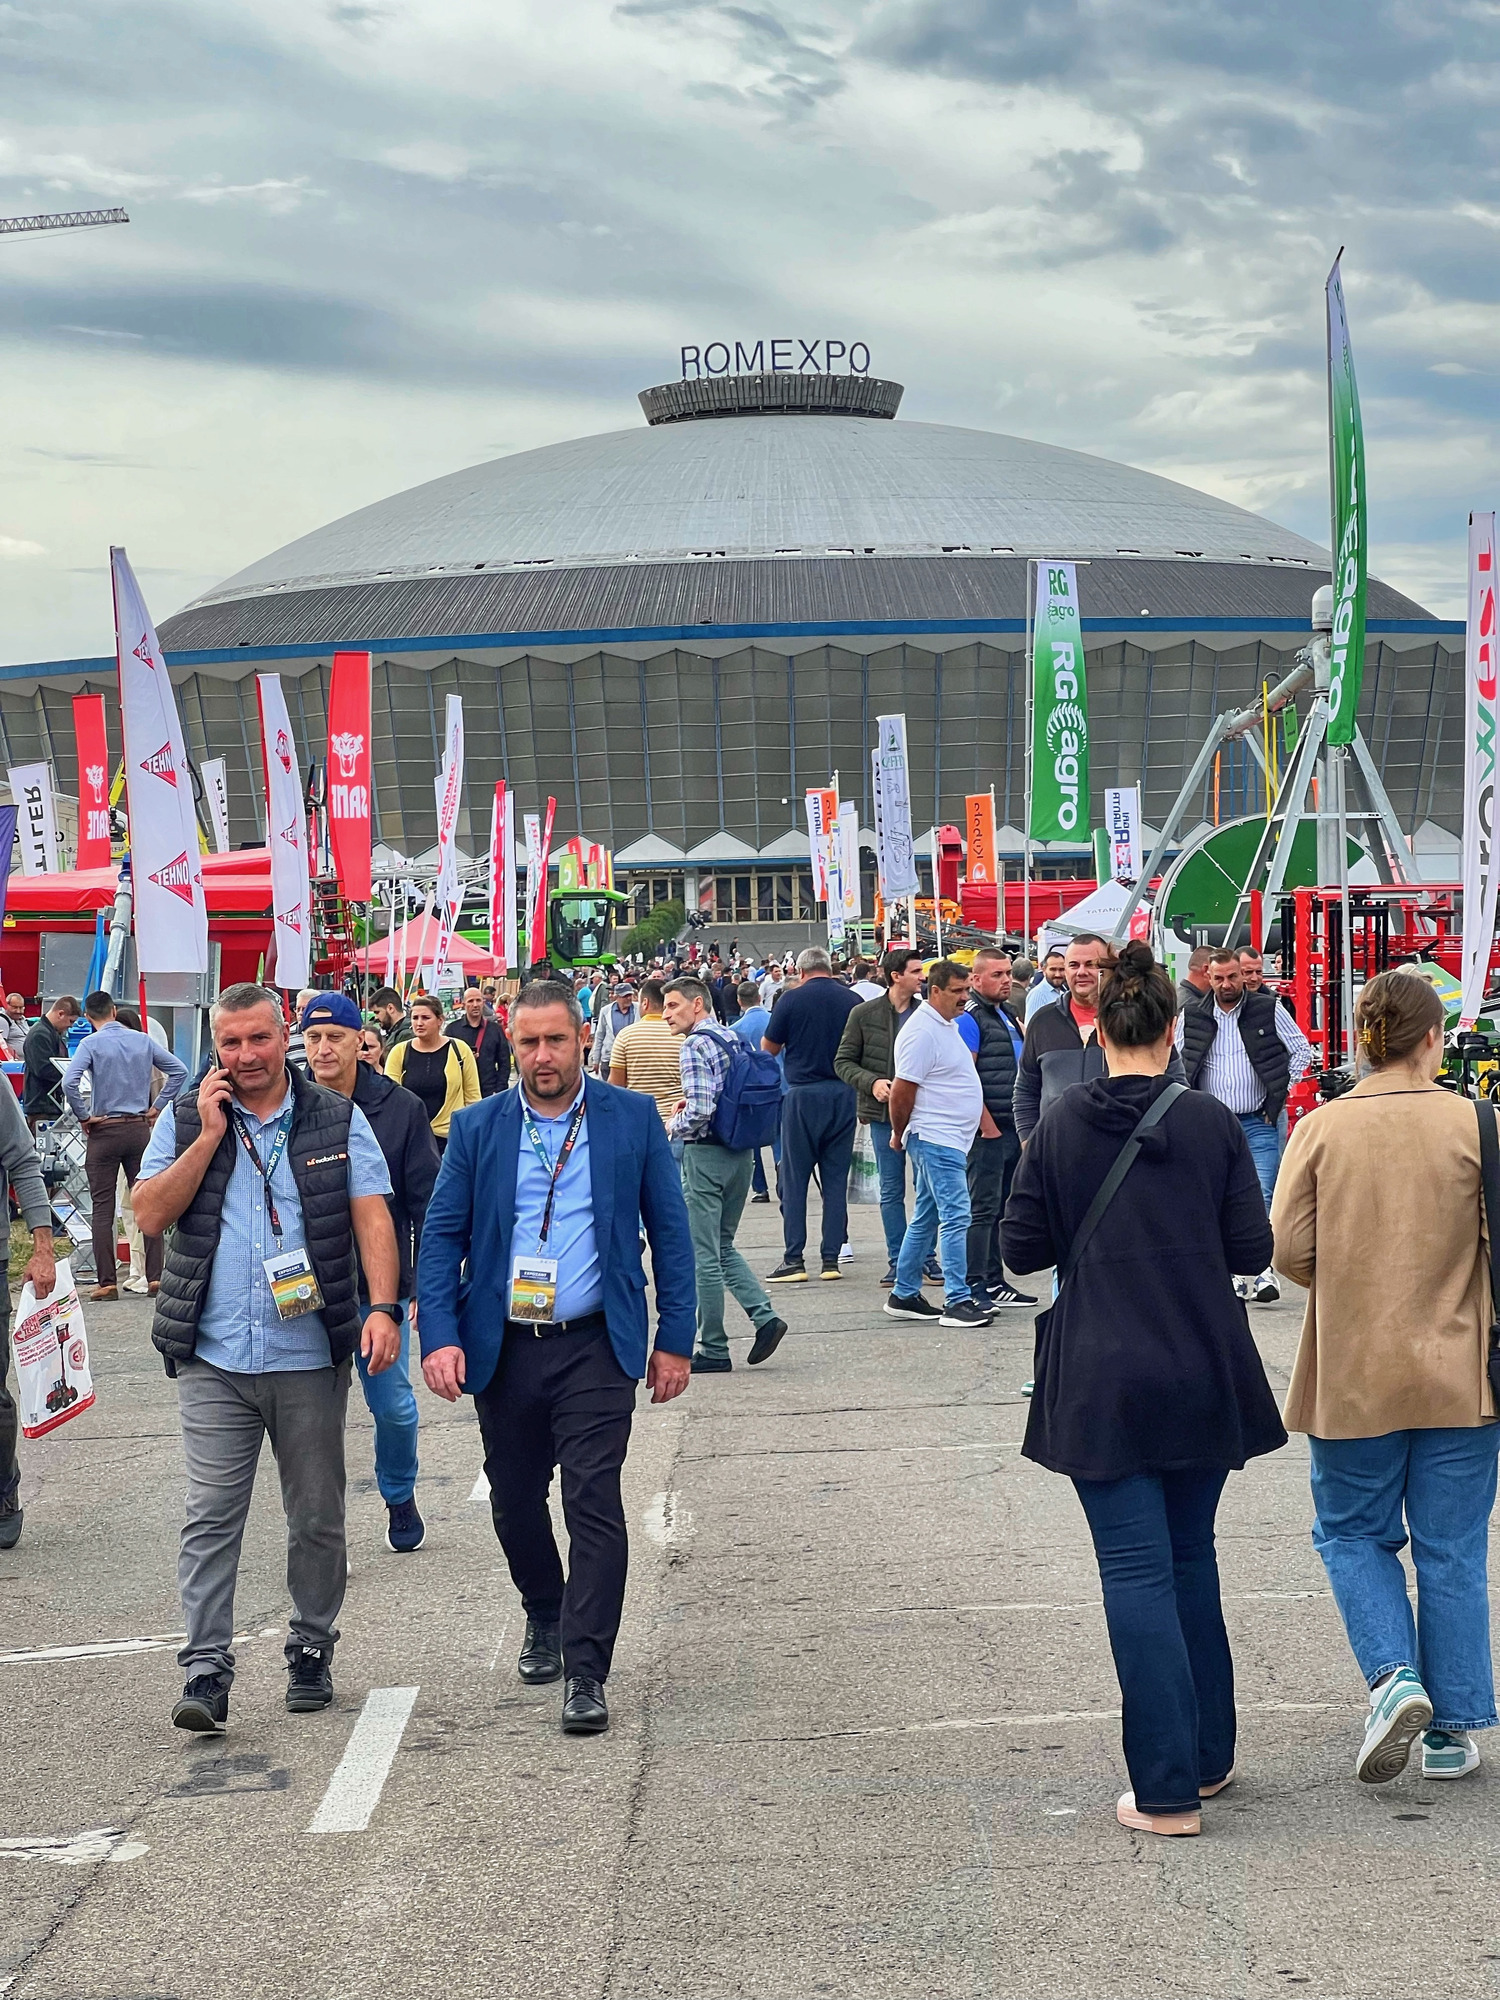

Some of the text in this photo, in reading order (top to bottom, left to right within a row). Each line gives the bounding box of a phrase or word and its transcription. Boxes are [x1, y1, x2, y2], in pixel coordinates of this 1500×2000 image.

[681, 340, 870, 378] ROMEXPO
[1048, 569, 1069, 596] RG
[1051, 642, 1079, 830] RG agro
